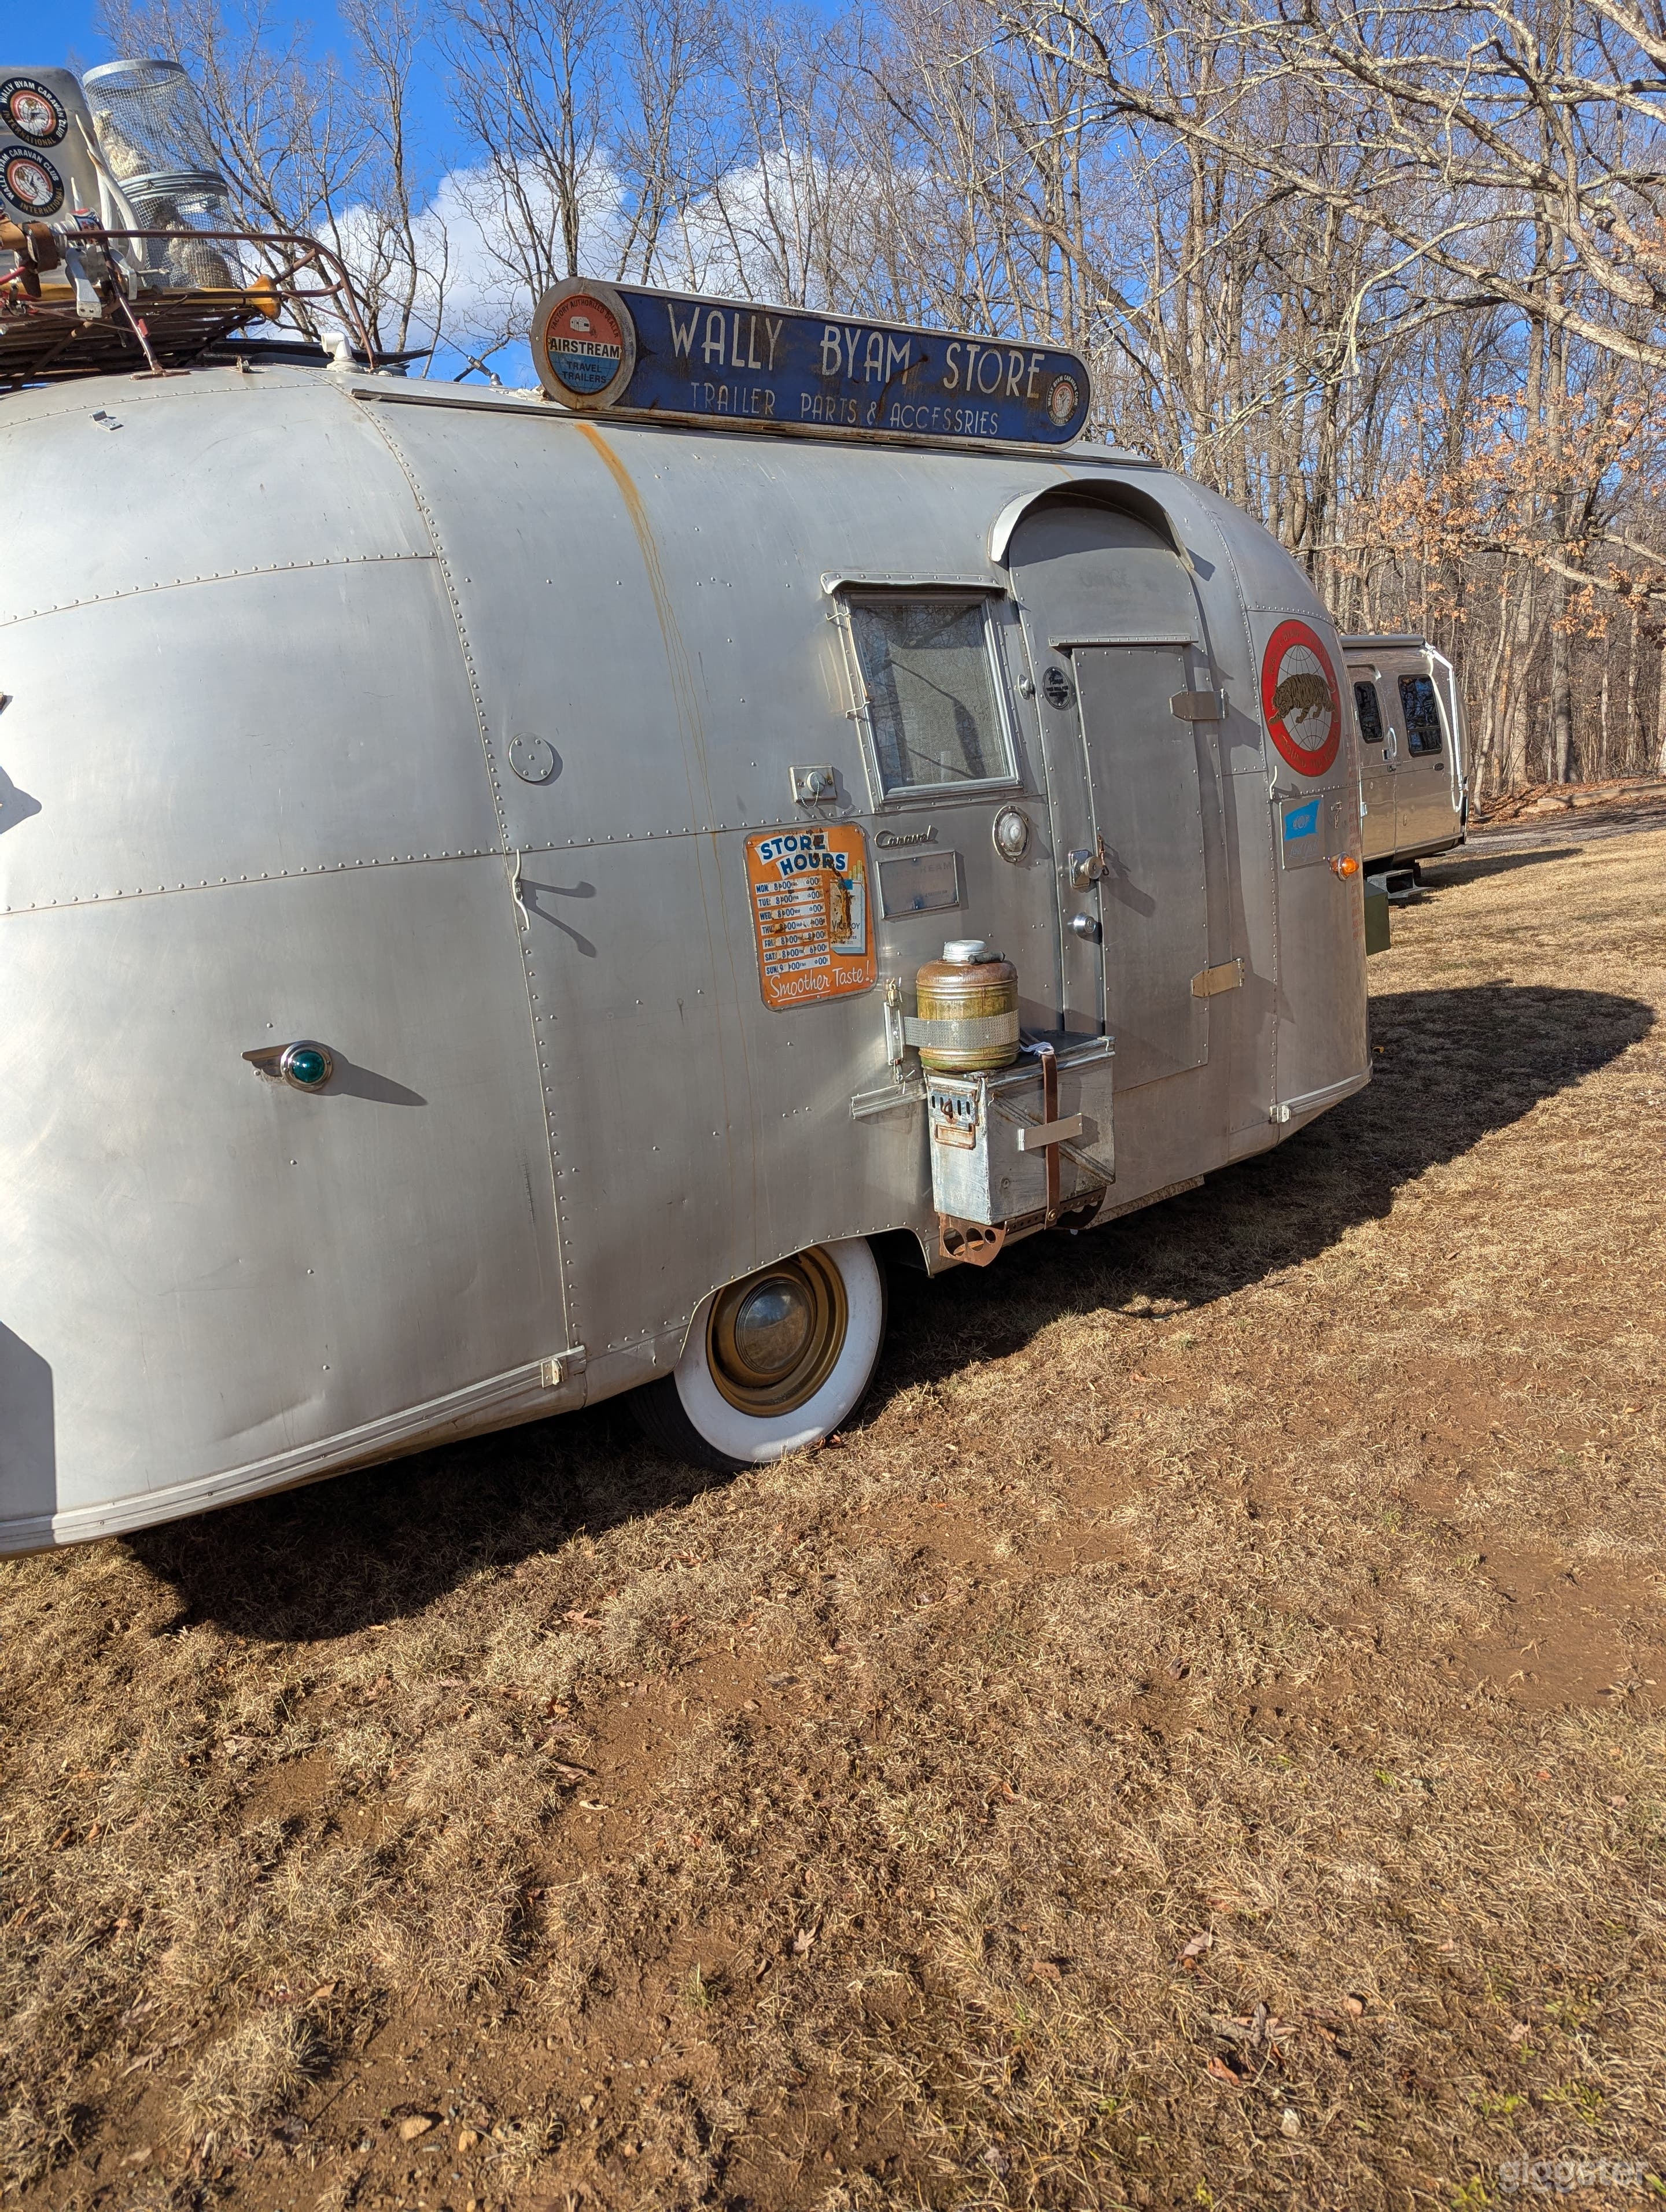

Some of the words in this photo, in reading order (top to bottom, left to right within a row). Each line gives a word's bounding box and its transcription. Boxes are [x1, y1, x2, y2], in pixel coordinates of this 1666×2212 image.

[1, 83, 14, 104] WALLY
[14, 80, 35, 90] BYAM
[38, 86, 64, 118] CARAVAN
[56, 119, 67, 138] CLUB
[3, 110, 56, 146] INTERNATIONAL
[9, 149, 43, 164] CARAVAN
[43, 162, 59, 181] CLUB
[20, 187, 62, 214] INTERNATIONAL
[551, 304, 569, 330] FACTORY
[570, 298, 605, 314] AUTHORIZED
[604, 308, 620, 338] DEALER
[550, 338, 620, 359] AIRSTREAM
[667, 303, 783, 371] WALLY
[820, 325, 911, 386] BYAM
[943, 342, 1045, 398] STORE
[562, 371, 606, 384] TRAILERS
[566, 361, 602, 373] TRAVEL
[691, 382, 776, 415] TRAILER
[800, 392, 857, 424] PARTS
[867, 401, 876, 426] &
[890, 402, 999, 435] ACCESSRIES
[760, 834, 825, 860] STORE
[874, 825, 931, 849] Caravel
[780, 853, 846, 876] HOURS
[832, 920, 861, 930] VICEOY
[770, 969, 831, 998] Smoother
